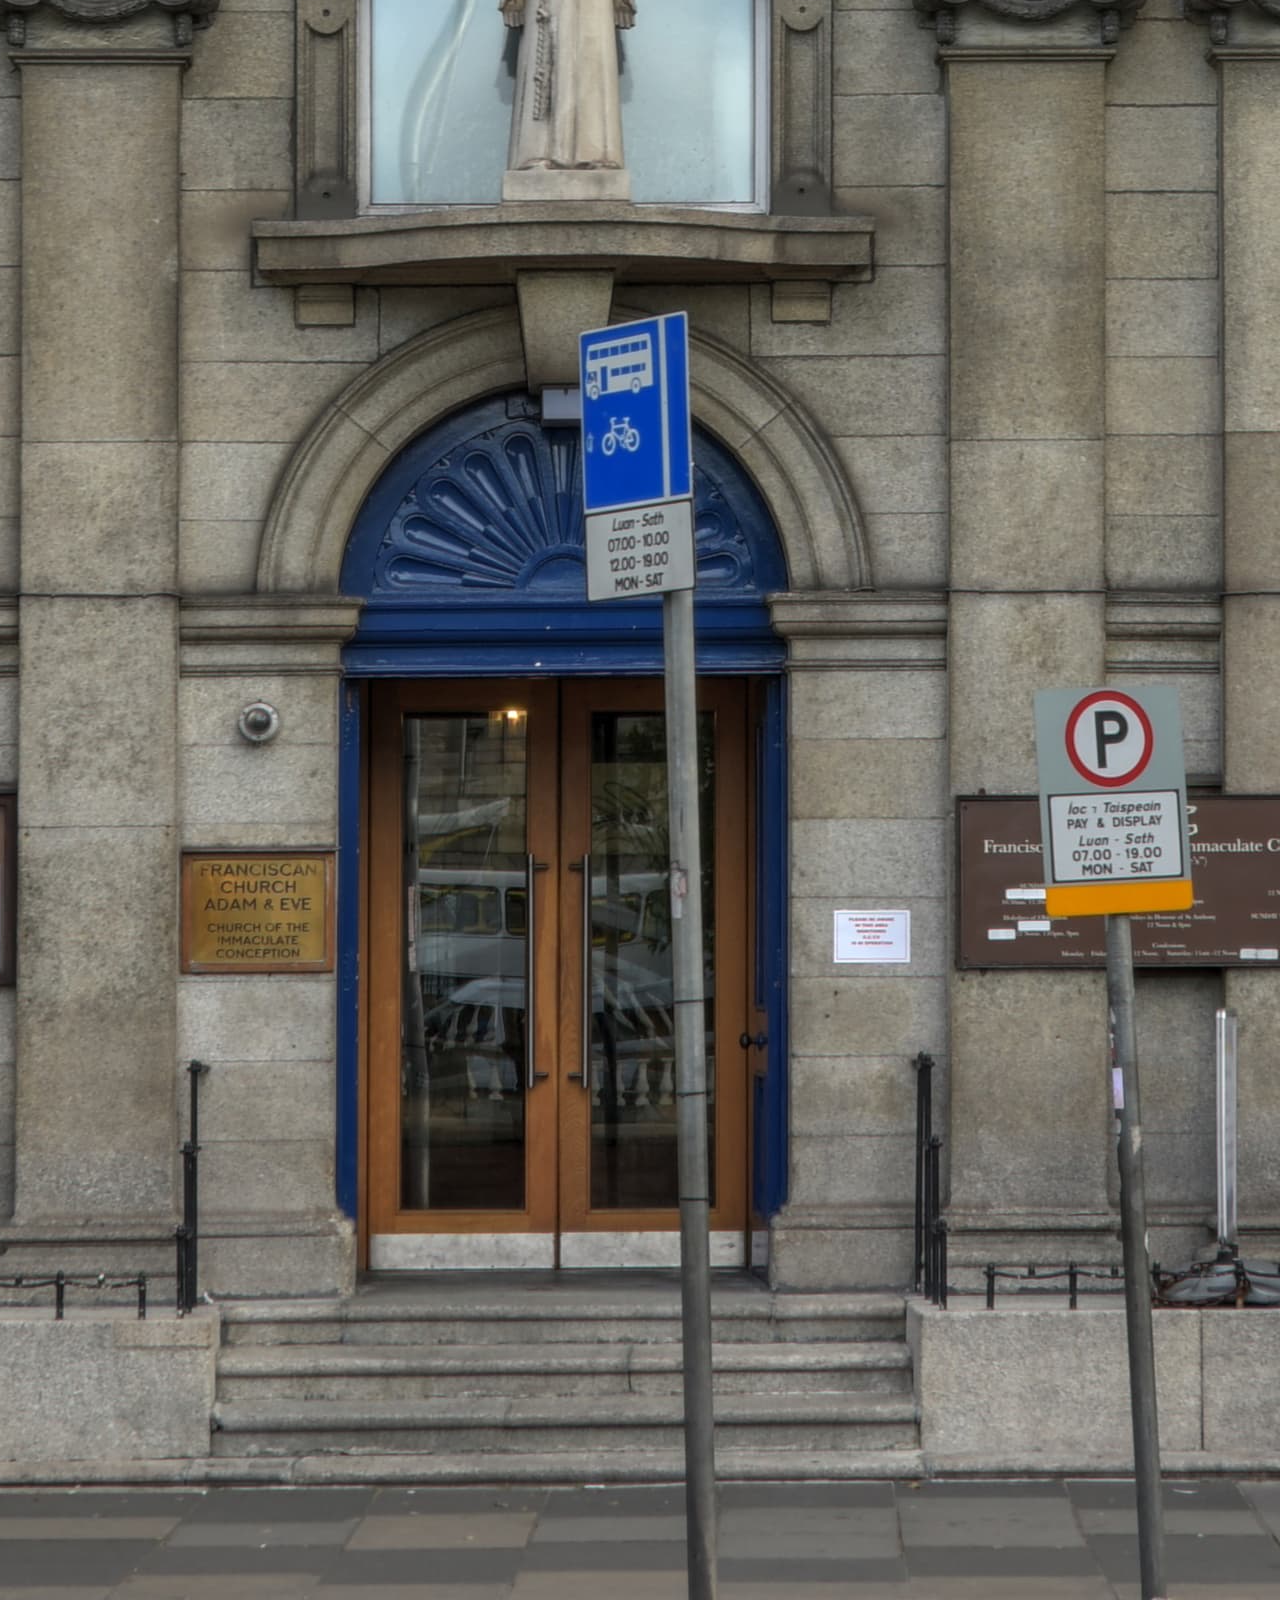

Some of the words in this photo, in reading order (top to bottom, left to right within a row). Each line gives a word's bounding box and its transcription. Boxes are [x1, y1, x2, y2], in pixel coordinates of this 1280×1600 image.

[1094, 710, 1129, 768] P
[1067, 818, 1088, 830] PAY
[1097, 817, 1105, 828] &
[1112, 815, 1162, 827] DISPLAY
[984, 839, 1044, 853] Francisc
[1079, 835, 1109, 846] Luan
[1124, 832, 1154, 844] Sath
[1072, 849, 1112, 862] 07.00
[1126, 846, 1162, 858] 19.00
[200, 863, 317, 876] FRANCISCAN
[1082, 863, 1112, 876] MON
[1130, 862, 1154, 873] SAT
[221, 880, 297, 894] CHURCH
[204, 898, 257, 911] ADAM
[264, 898, 274, 911] &
[280, 898, 312, 911] EVE
[207, 923, 260, 933] CHURCH
[265, 922, 282, 932] OF
[287, 922, 310, 932] THE
[217, 935, 299, 945] IMMACULATE
[216, 948, 300, 958] CONCEPTION
